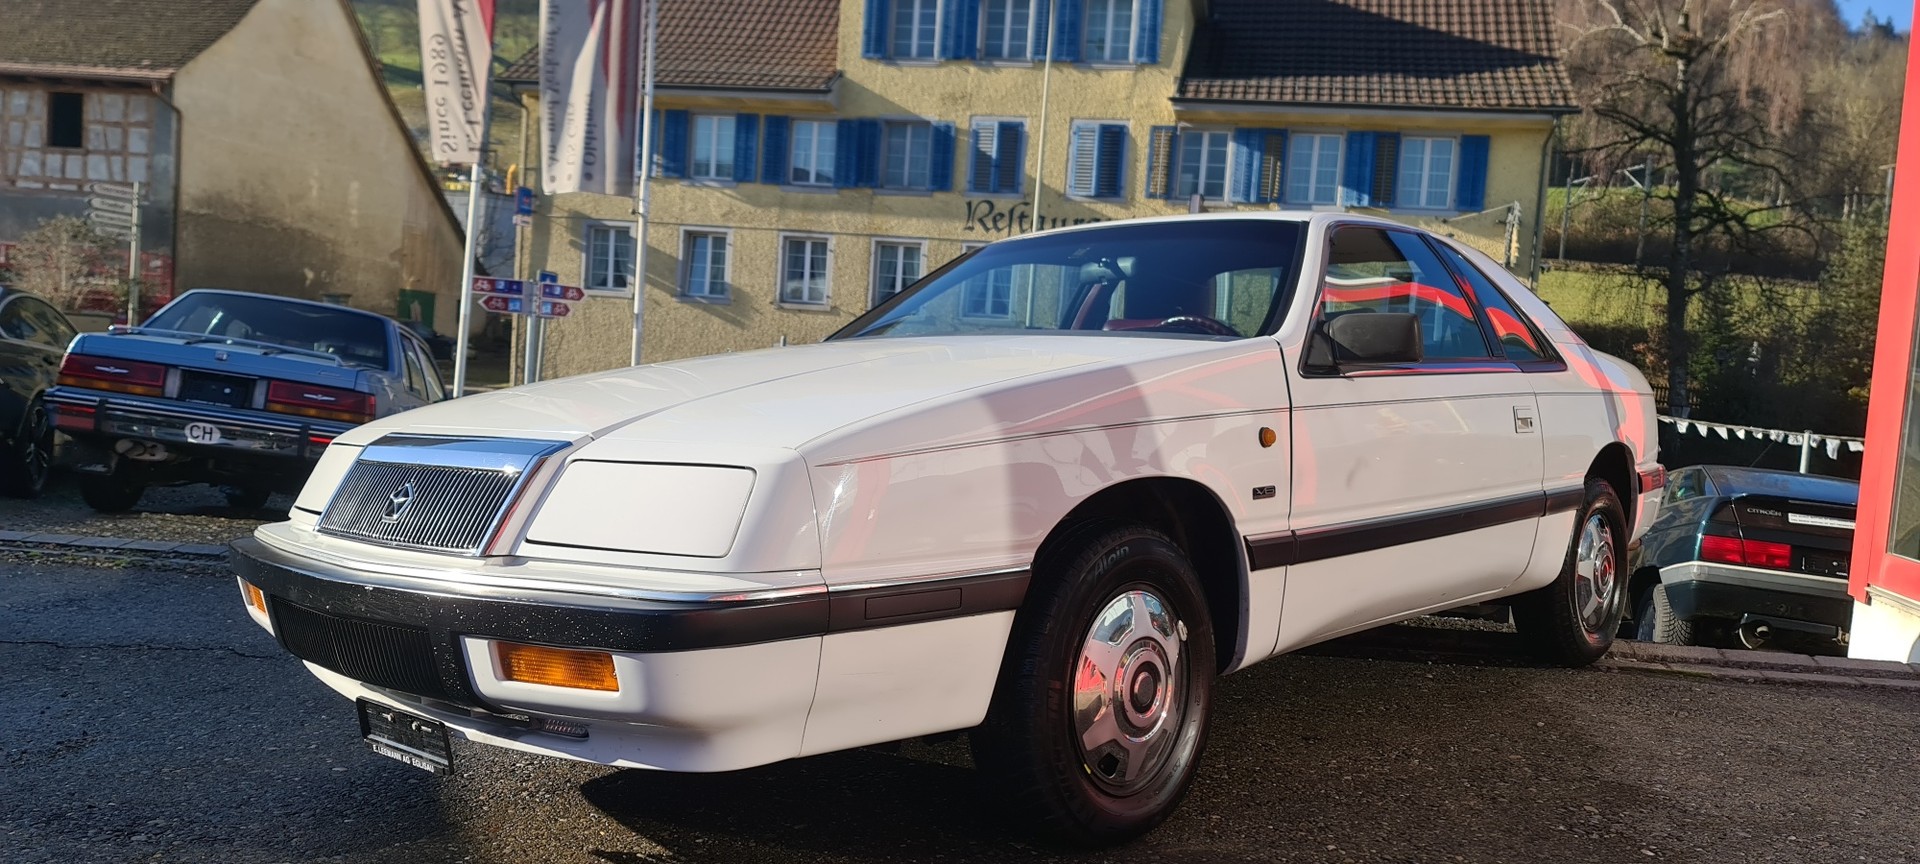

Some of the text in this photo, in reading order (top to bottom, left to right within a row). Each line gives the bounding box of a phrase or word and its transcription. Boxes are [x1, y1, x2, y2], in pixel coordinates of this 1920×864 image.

[189, 424, 213, 442] CH
[1256, 486, 1275, 495] V6
[378, 745, 402, 762] LEEMANN
[402, 755, 411, 764] AG
[412, 757, 435, 773] EGLISAU
